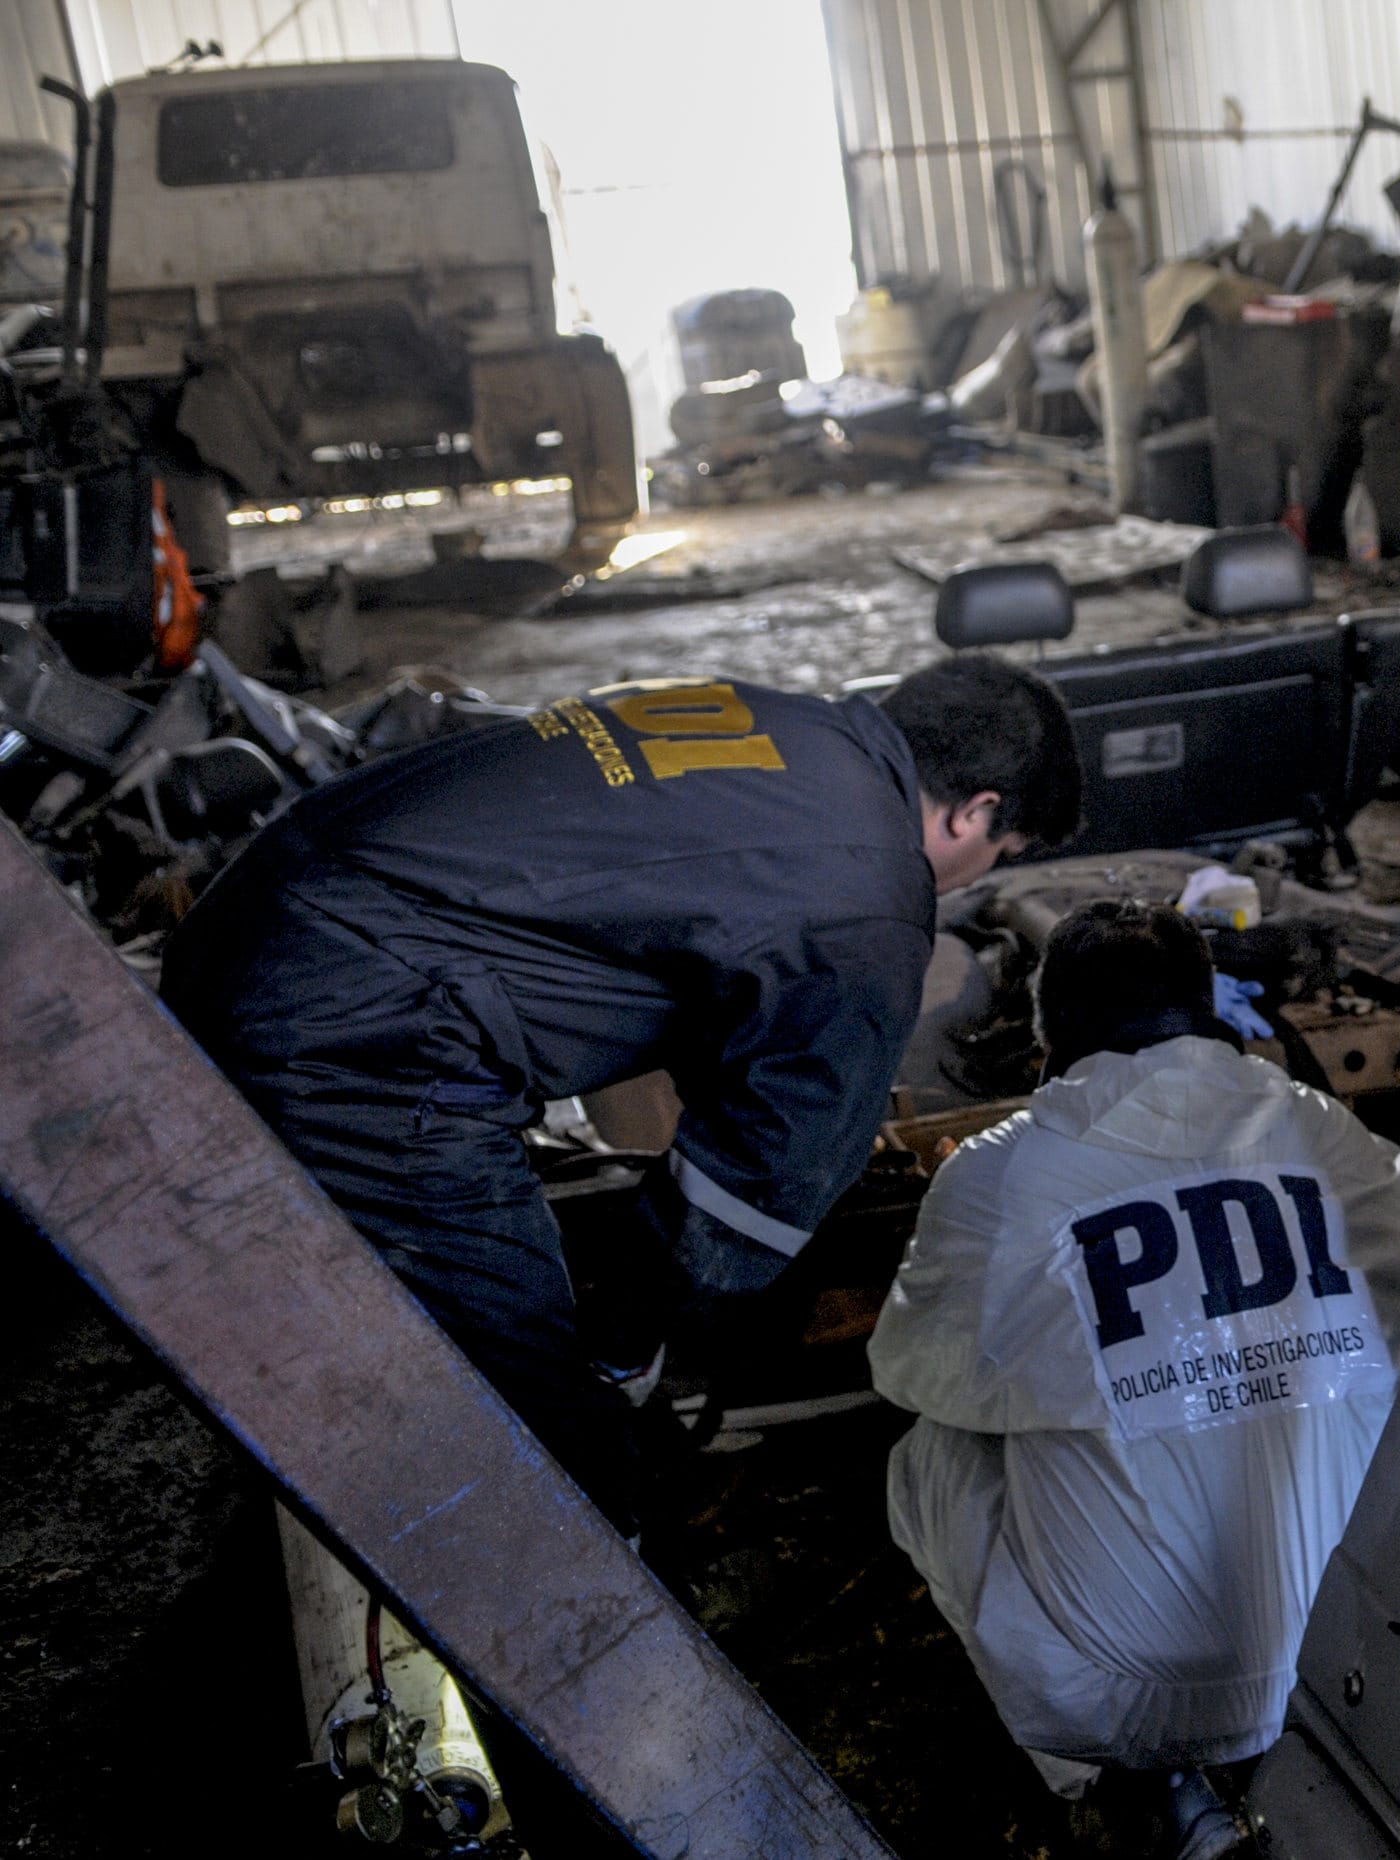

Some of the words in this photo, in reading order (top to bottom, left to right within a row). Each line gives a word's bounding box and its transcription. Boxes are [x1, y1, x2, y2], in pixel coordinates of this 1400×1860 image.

[1071, 1174, 1353, 1349] PDI
[1183, 1358, 1209, 1384] DE
[1212, 1326, 1365, 1379] INVESTIGACIONES
[1207, 1387, 1234, 1413] DE
[1237, 1373, 1291, 1407] CHILE
